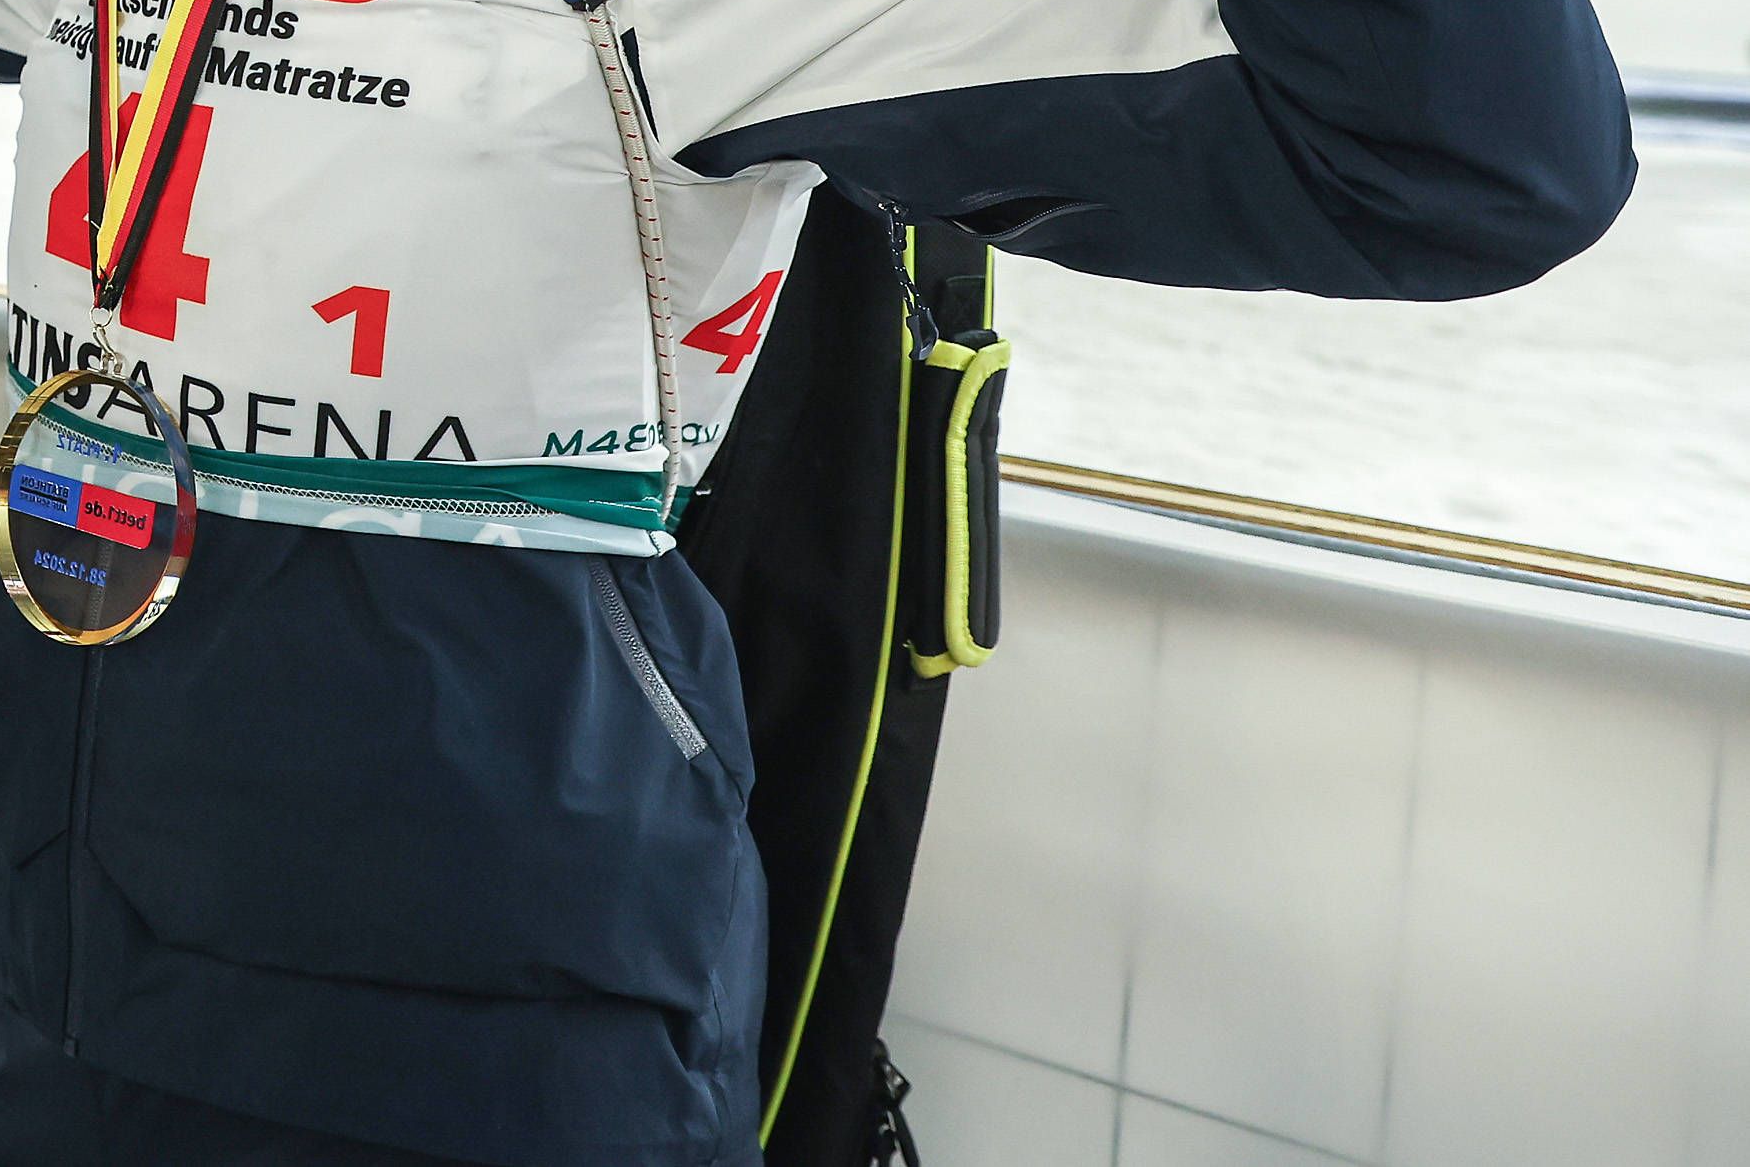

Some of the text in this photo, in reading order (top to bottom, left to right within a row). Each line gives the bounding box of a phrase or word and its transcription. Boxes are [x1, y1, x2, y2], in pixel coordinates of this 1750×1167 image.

[204, 46, 411, 109] Matratze
[45, 92, 211, 342] 4
[311, 285, 391, 379] 1
[680, 270, 785, 375] 4
